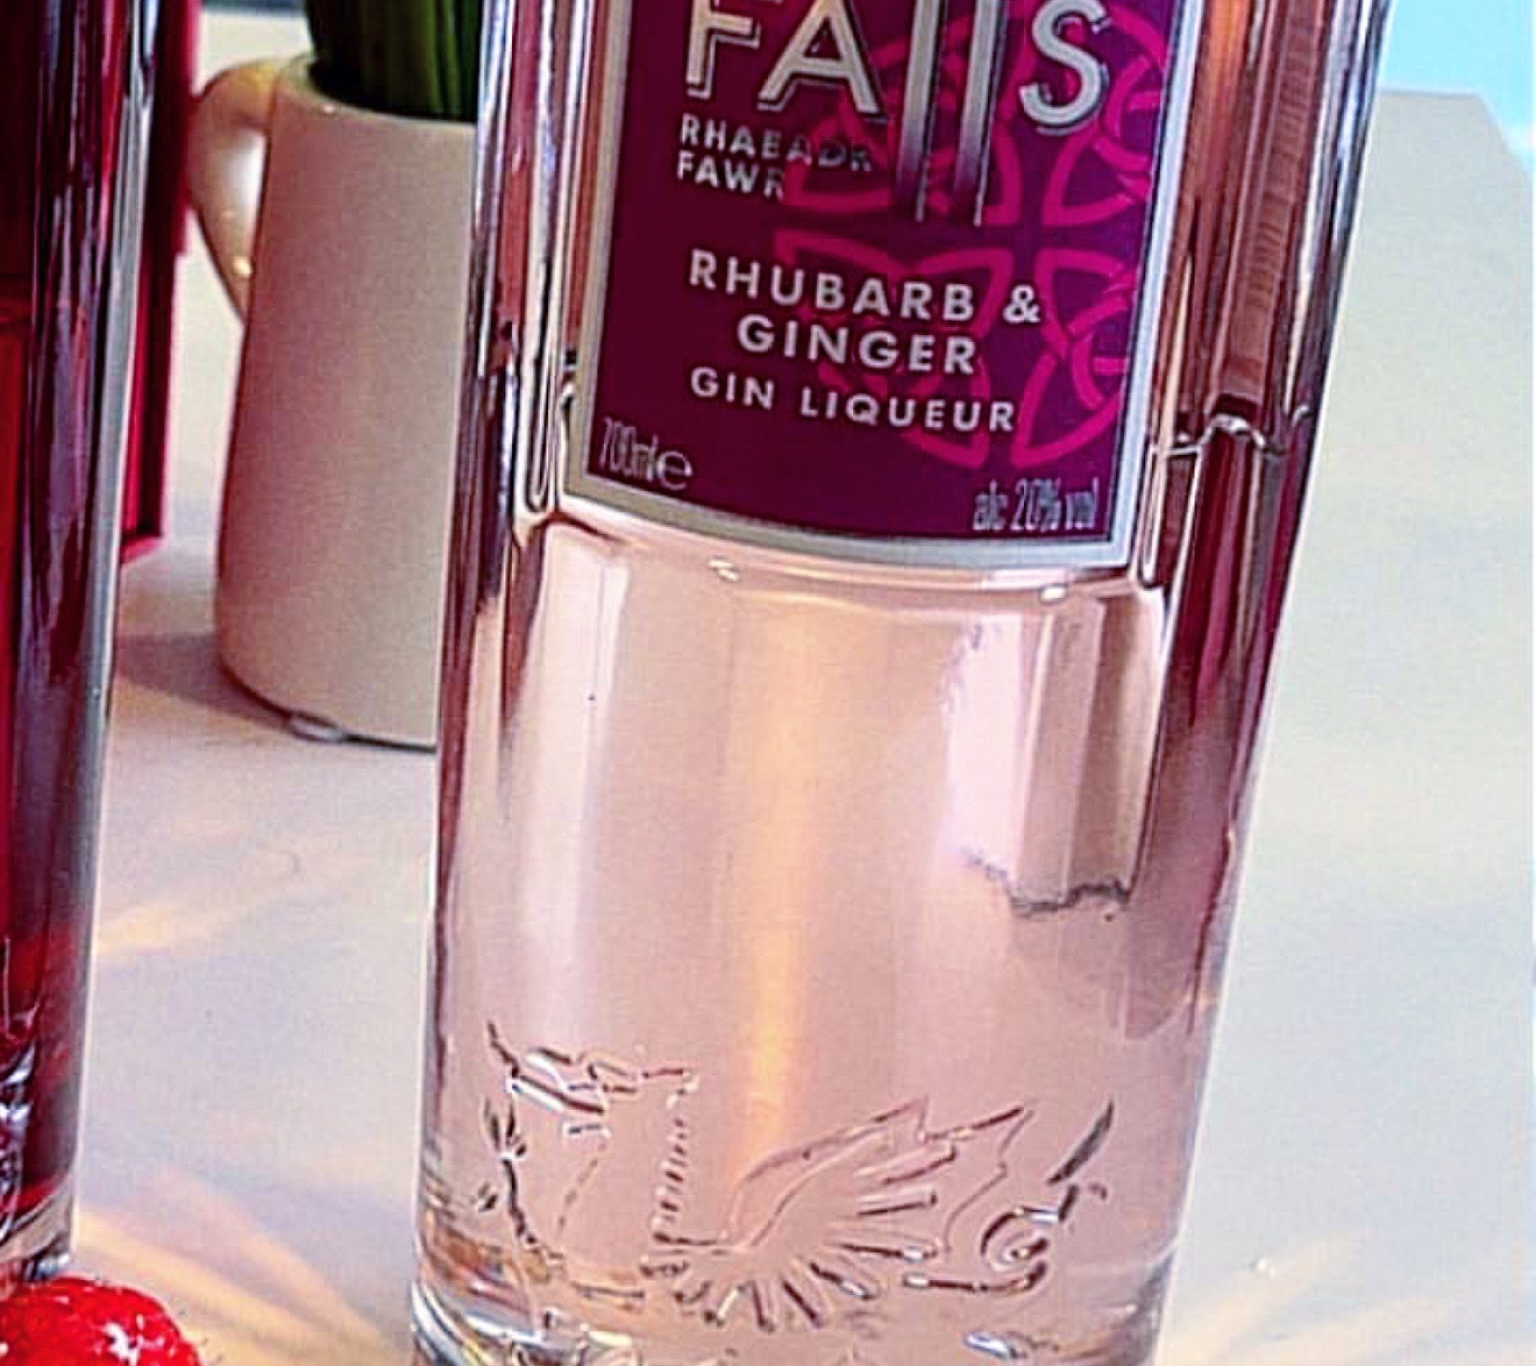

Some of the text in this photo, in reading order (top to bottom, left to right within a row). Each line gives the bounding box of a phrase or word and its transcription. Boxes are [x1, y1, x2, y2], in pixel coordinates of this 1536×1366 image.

[675, 148, 786, 202] FAWR
[688, 248, 1042, 325] RHUBARB &
[736, 314, 977, 376] GINGER
[689, 366, 1014, 432] GIN LIQUEUR
